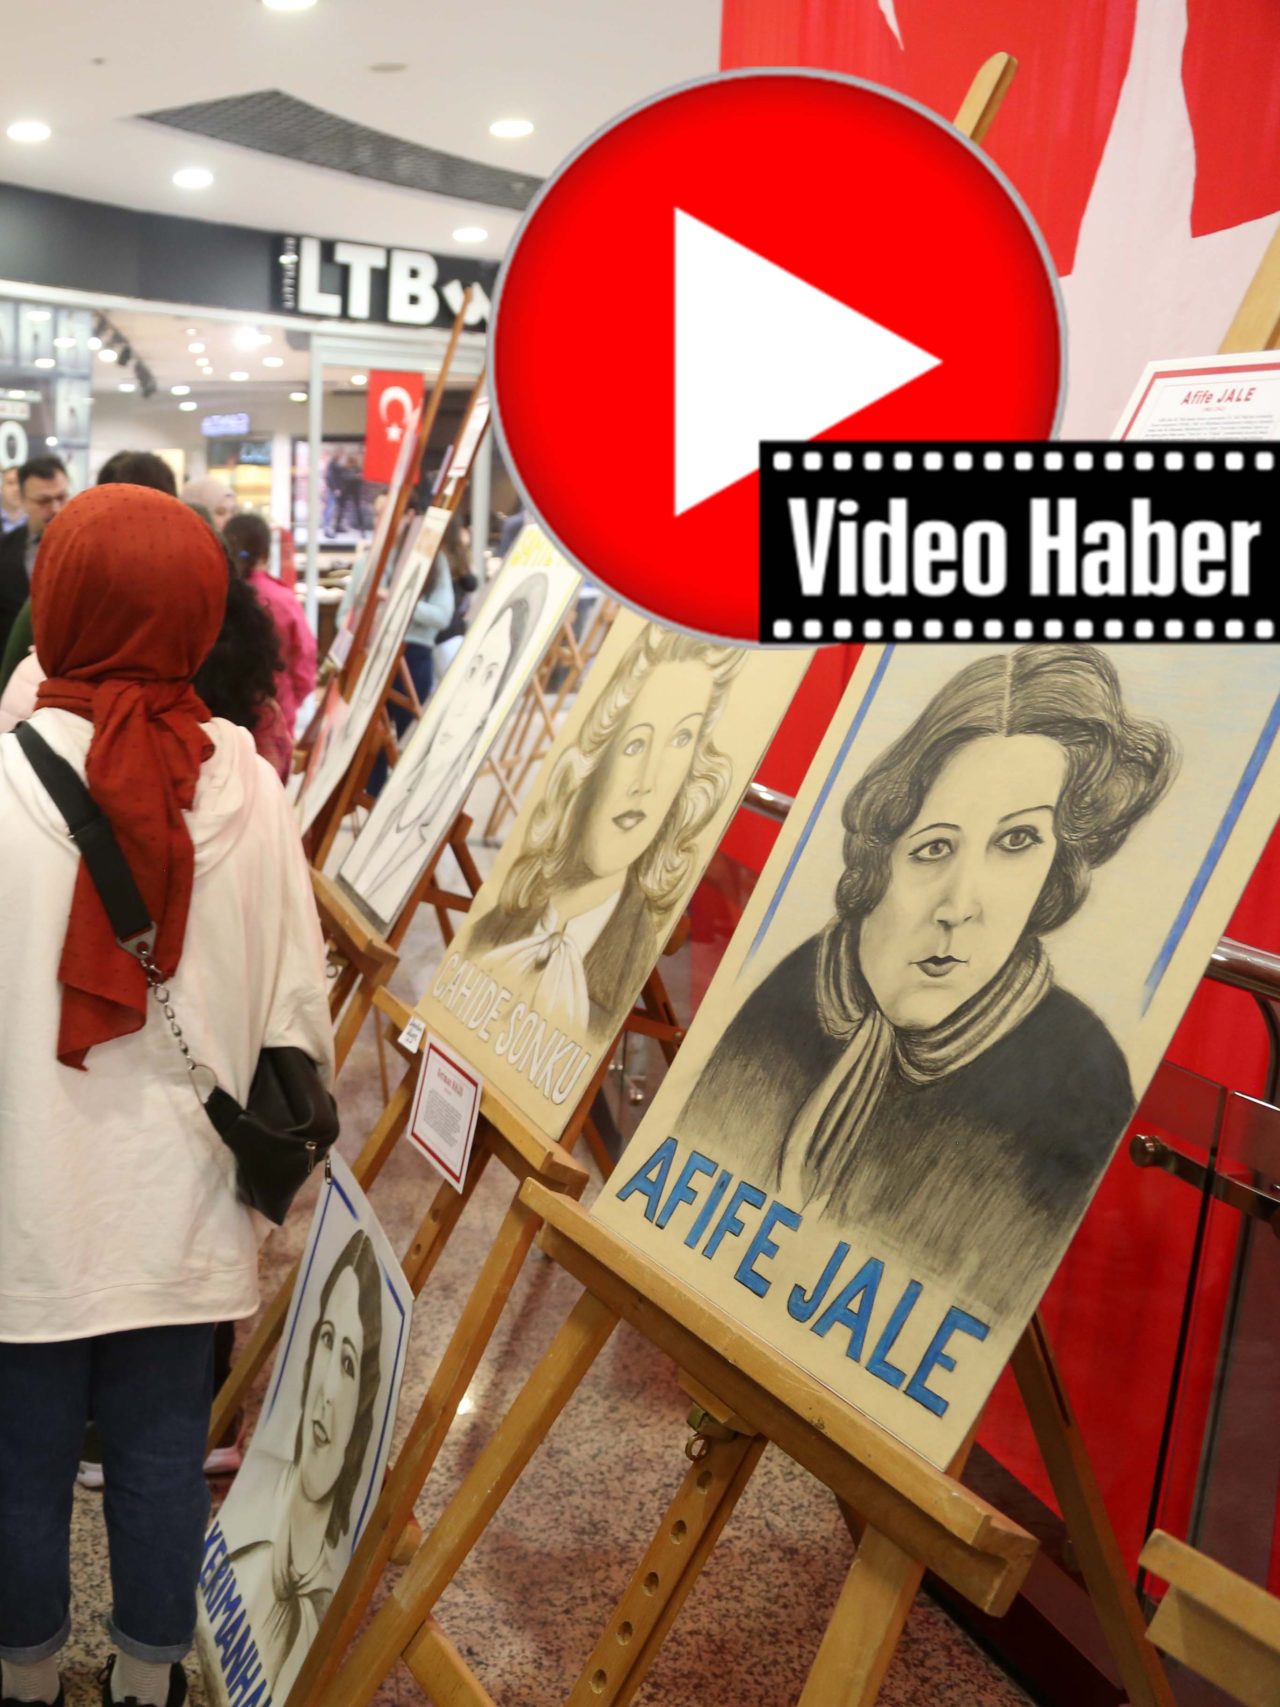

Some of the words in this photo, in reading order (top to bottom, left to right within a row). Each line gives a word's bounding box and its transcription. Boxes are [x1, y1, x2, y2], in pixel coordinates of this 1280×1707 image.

[298, 236, 440, 326] LTB
[1216, 387, 1257, 403] JALE
[495, 1002, 592, 1105] SONKU
[616, 1136, 803, 1299] AFIFE
[787, 1240, 991, 1418] JALE
